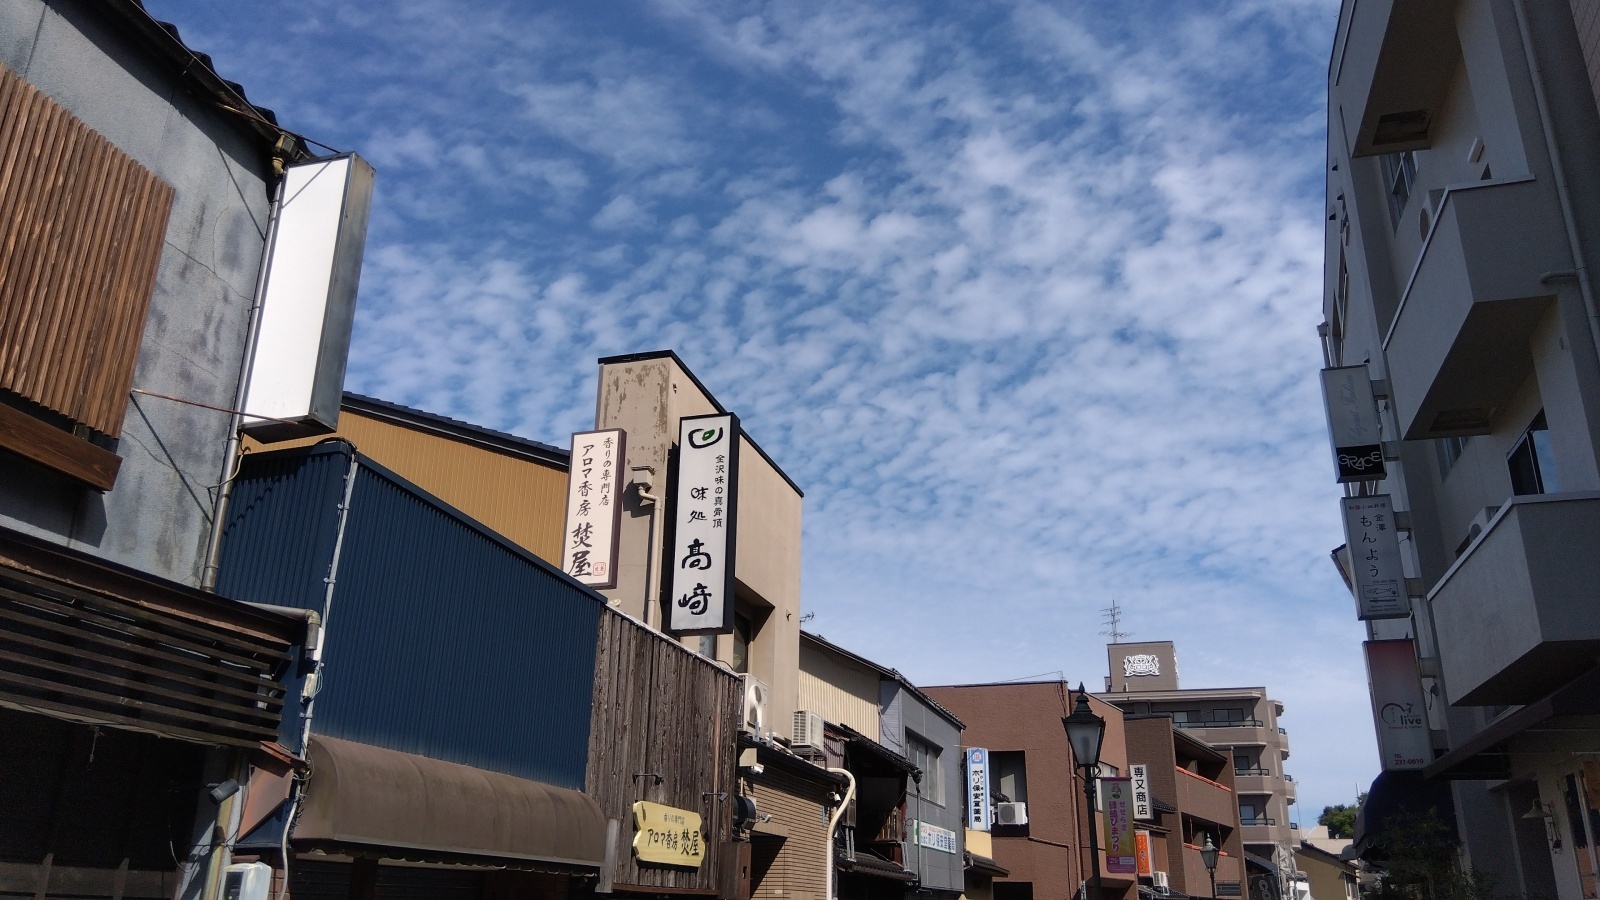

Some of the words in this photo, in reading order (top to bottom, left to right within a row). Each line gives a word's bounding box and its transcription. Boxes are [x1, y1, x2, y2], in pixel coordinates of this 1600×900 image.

[576, 444, 595, 517] アロマ香房
[599, 437, 614, 506] 香りの専門店
[1337, 451, 1381, 470] GRACE
[688, 487, 709, 524] 味処
[712, 454, 726, 528] 金沢味の真骨頂
[569, 522, 594, 577] 焚屋
[1360, 515, 1379, 578] もんよう
[1133, 767, 1148, 816] 専又商店
[648, 829, 678, 851] アロマ香房
[681, 828, 699, 856] 焚屋
